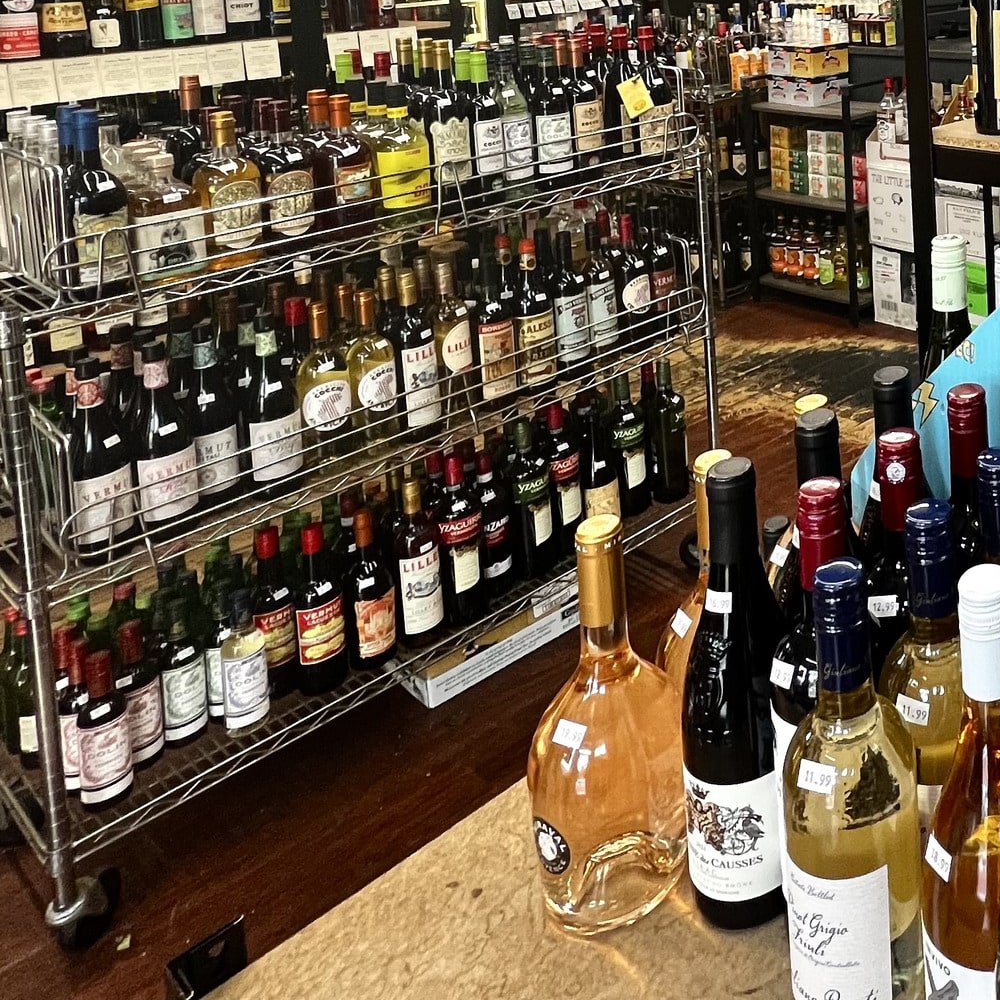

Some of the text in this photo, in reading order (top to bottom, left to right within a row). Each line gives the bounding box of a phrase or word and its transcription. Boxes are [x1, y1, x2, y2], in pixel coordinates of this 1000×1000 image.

[884, 175, 904, 188] LITTLE
[873, 601, 895, 612] 12.99
[902, 703, 928, 720] 11.99
[804, 769, 832, 787] 11.99
[711, 854, 764, 870] CAUSSES
[809, 913, 848, 946] Grigio
